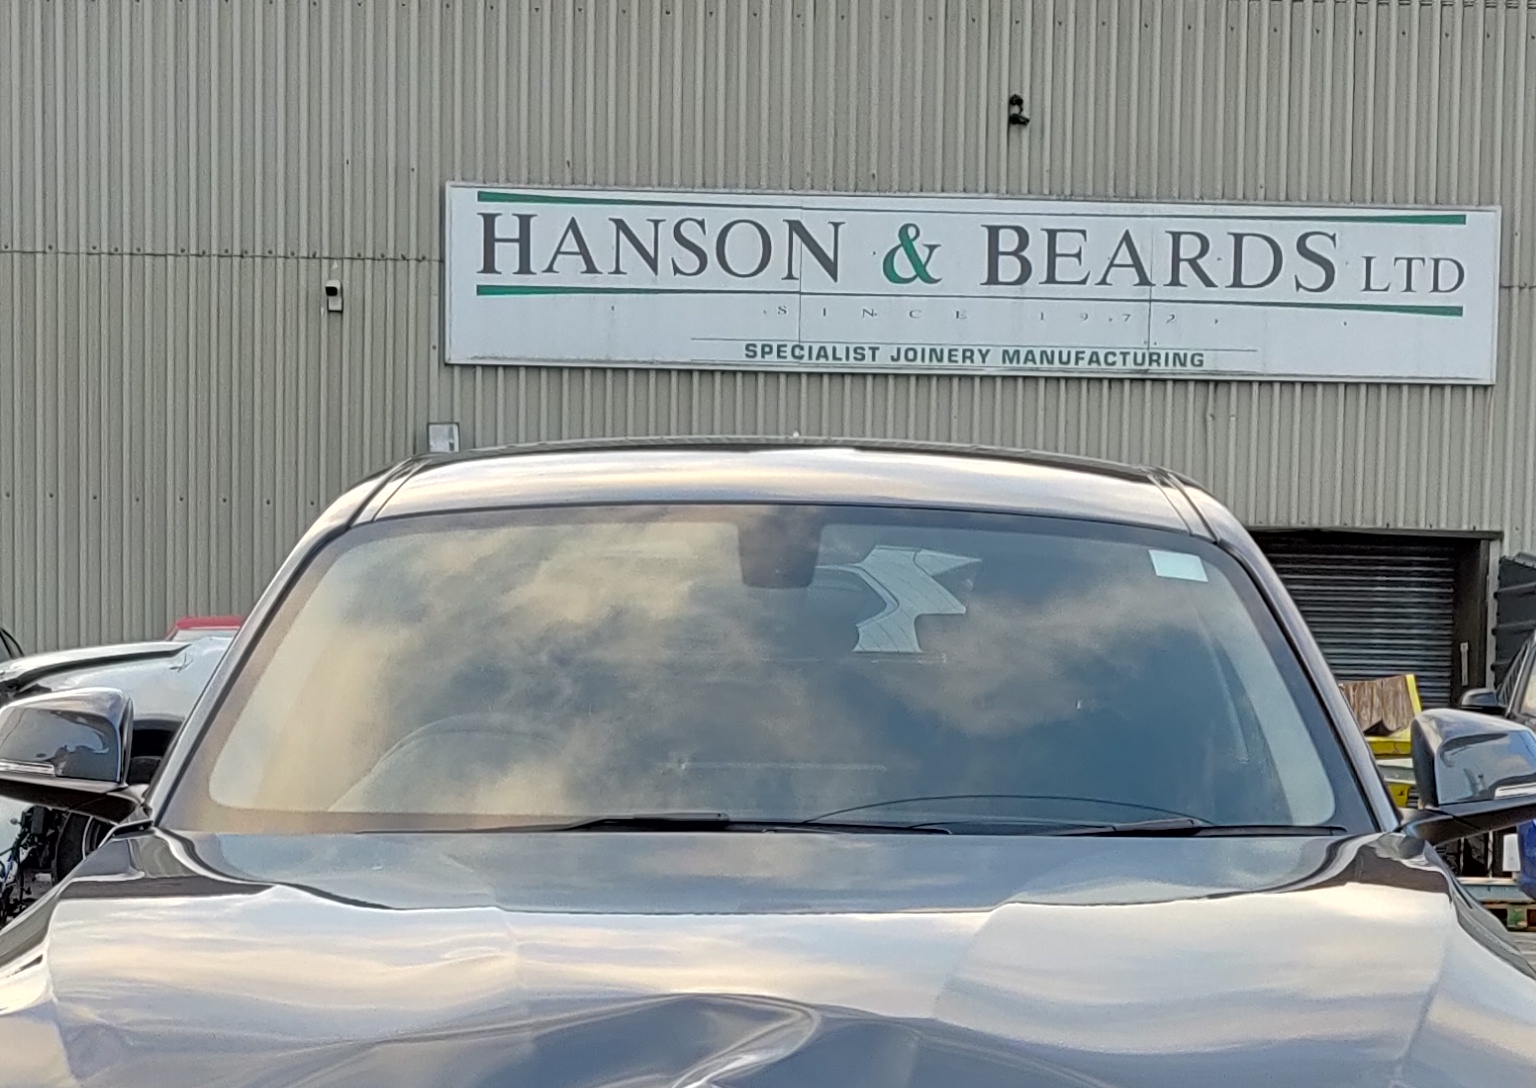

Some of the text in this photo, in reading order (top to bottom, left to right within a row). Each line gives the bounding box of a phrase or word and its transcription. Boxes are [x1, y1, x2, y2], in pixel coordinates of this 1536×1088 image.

[476, 211, 1465, 294] HANSON & BEARDS LTD
[744, 342, 1205, 368] SPECIALIST JOINERY MANUFACTURING
